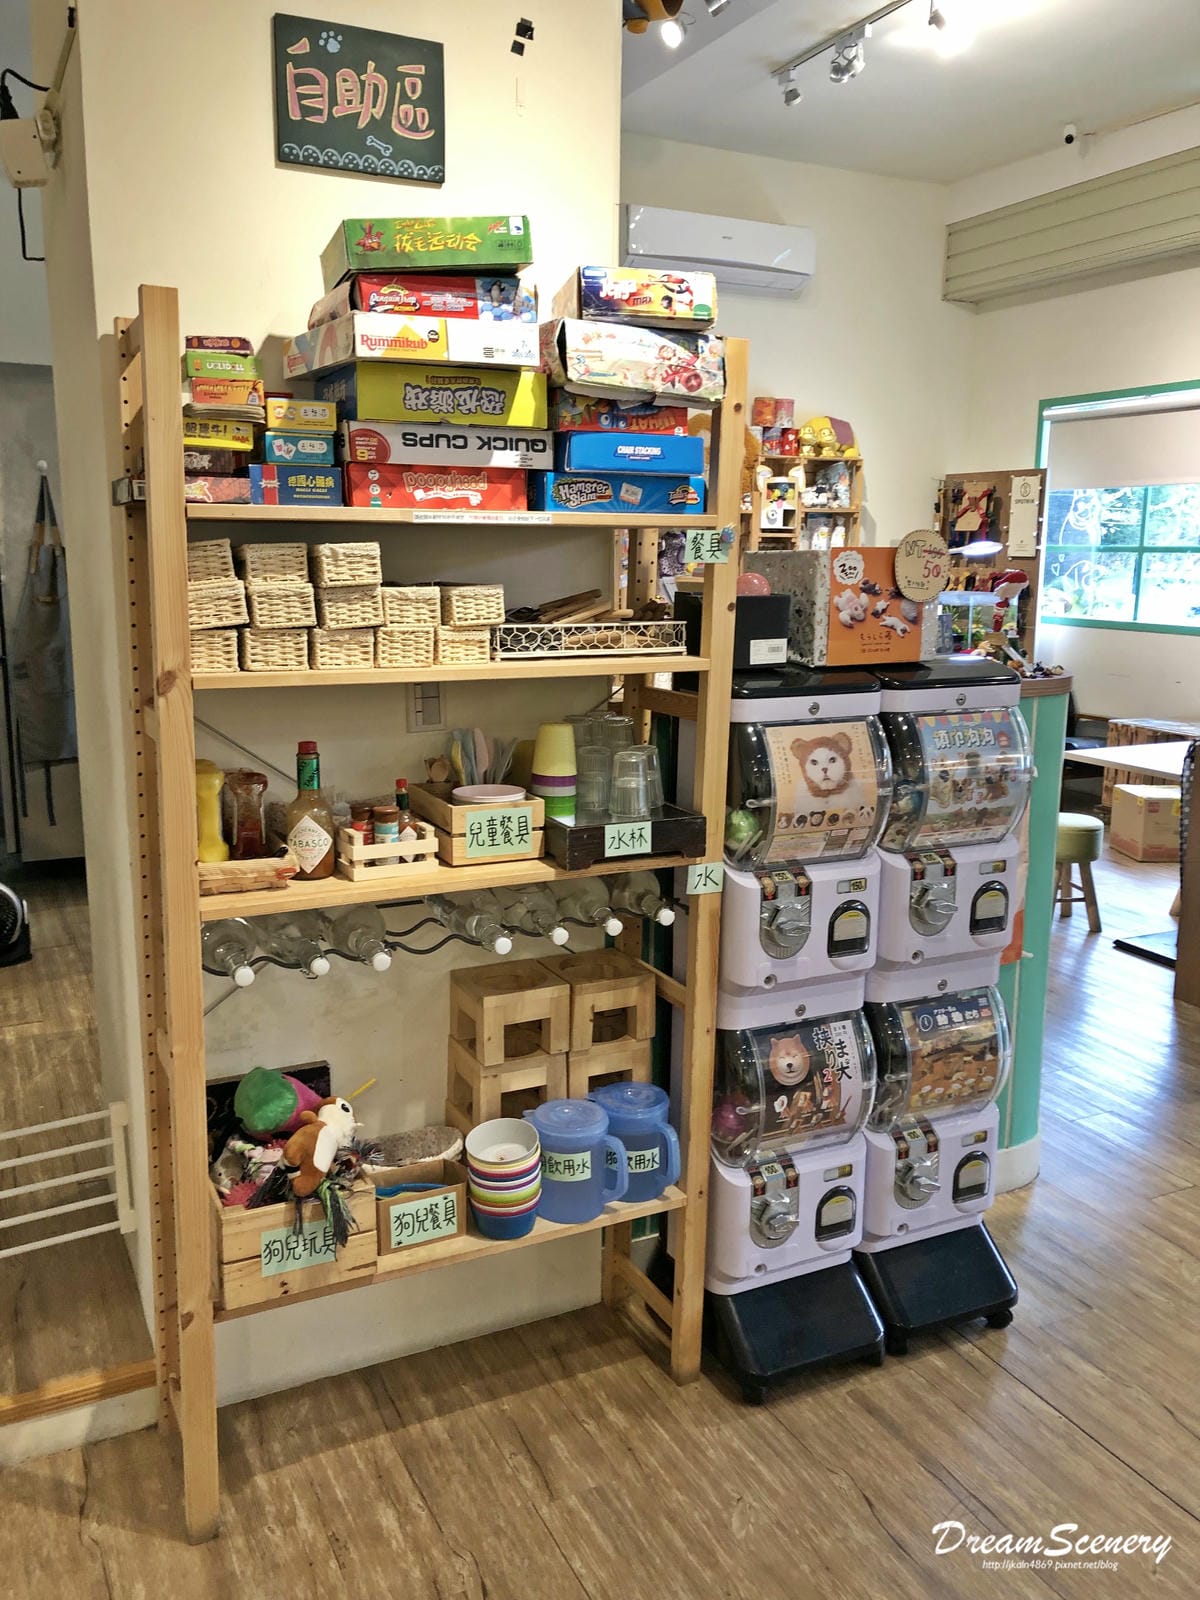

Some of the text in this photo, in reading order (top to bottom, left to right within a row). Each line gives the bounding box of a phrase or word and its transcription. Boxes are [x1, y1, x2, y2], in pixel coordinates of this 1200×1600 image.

[286, 37, 435, 140] 自助區
[360, 334, 428, 351] Rummikub
[403, 382, 506, 415] 恐龙游戏
[401, 432, 547, 454] QUICK CUPS
[558, 481, 609, 499] Hamster
[569, 492, 597, 507] Slam
[691, 532, 722, 560] 餐具
[289, 837, 330, 849] TABASCO
[468, 815, 530, 849] 兒童餐具
[608, 827, 649, 850] 水杯
[694, 865, 719, 890] 水
[393, 1198, 456, 1238] 狗兒餐具
